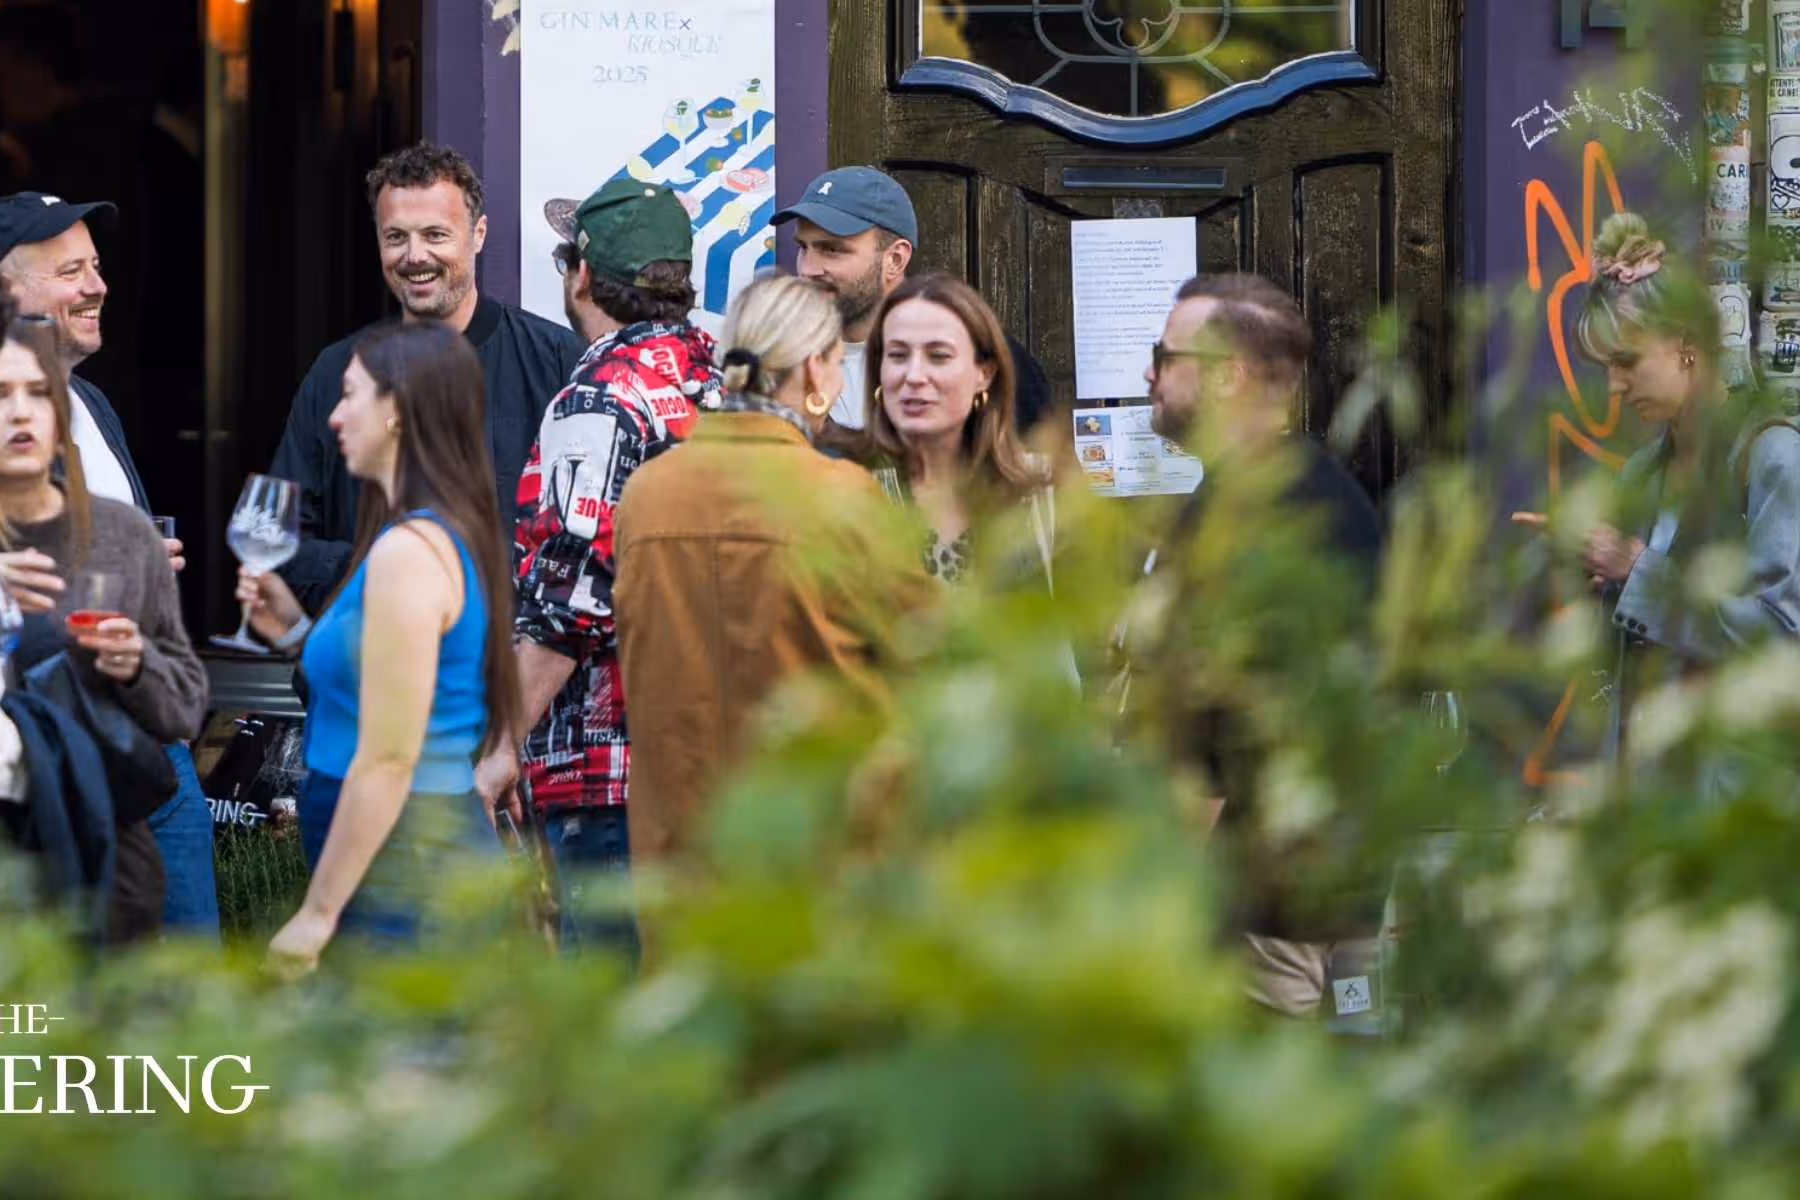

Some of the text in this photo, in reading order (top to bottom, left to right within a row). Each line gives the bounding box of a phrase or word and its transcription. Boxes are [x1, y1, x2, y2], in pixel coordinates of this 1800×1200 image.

[539, 10, 591, 31] GIN
[599, 10, 677, 31] MARE
[592, 64, 648, 83] 2025
